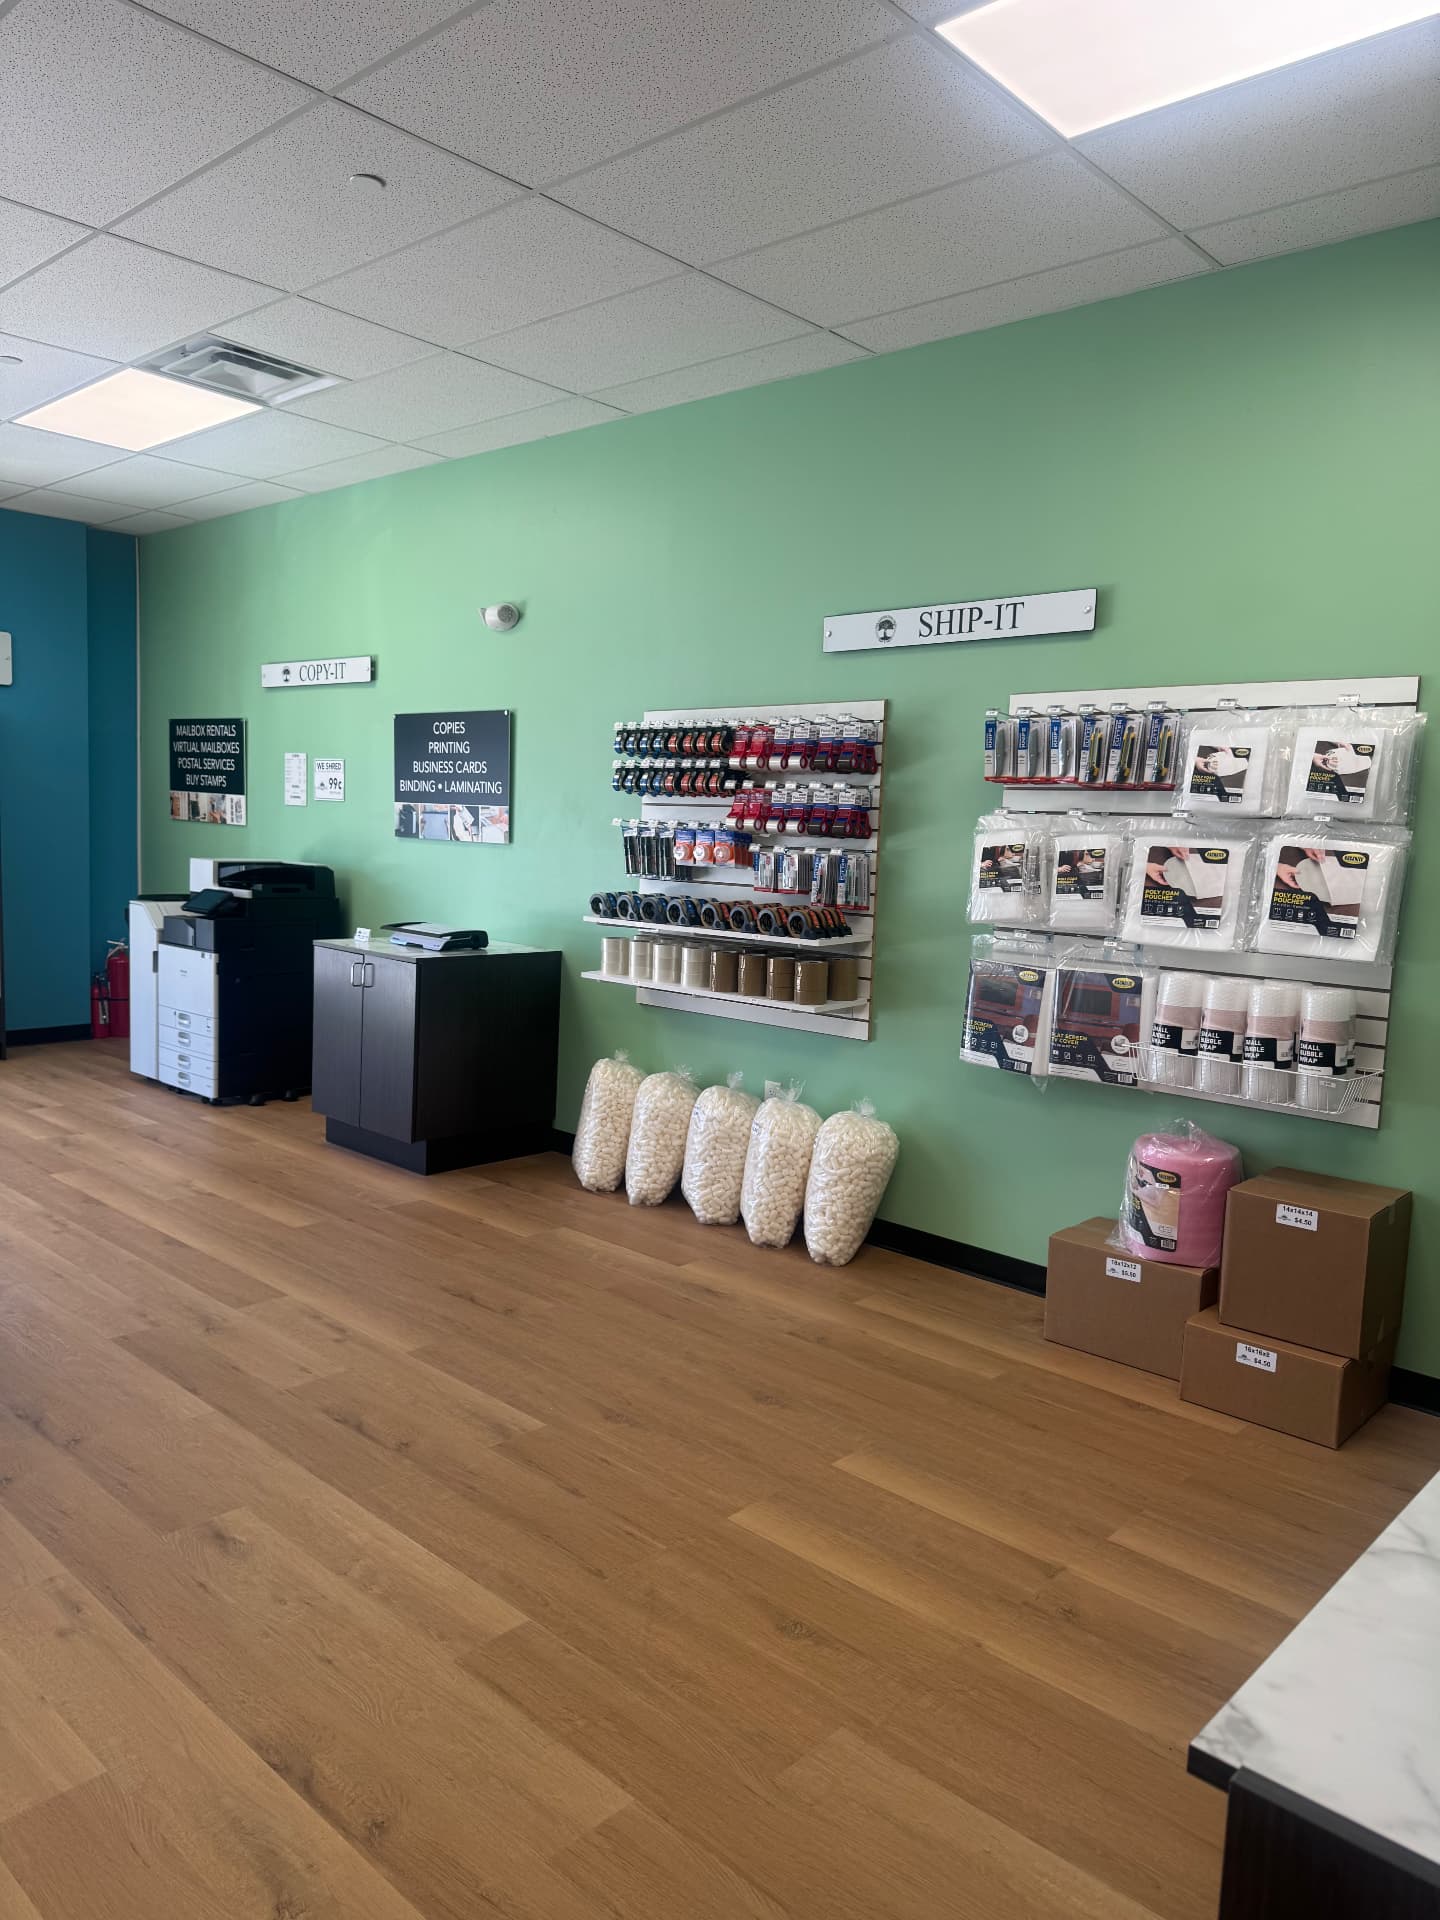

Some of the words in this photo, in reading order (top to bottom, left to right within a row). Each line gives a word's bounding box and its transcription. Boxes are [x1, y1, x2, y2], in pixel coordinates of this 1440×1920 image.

[919, 602, 1025, 638] SHIP-IT
[299, 662, 346, 681] COPY-IT
[176, 724, 206, 737] MAILBOX
[206, 724, 236, 737] RENTALS
[433, 721, 465, 734] COPIES
[172, 741, 200, 753] VIRTUAL
[201, 742, 240, 754] MAILBOXES
[428, 741, 470, 753] PRINTING
[178, 757, 201, 769] POSTAL
[202, 758, 235, 771] SERVICES
[317, 762, 325, 770] WE
[325, 762, 342, 770] SHRED
[413, 761, 453, 773] BUSINESS
[456, 761, 487, 774] CARDS
[186, 774, 199, 785] BUY
[200, 774, 227, 787] STAMPS
[329, 777, 342, 790] 99¢
[400, 780, 435, 792] BINDING
[444, 781, 502, 794] LAMINATING
[1273, 897, 1304, 905] POUCHES
[1201, 1030, 1219, 1038] SMALL
[1300, 1043, 1320, 1051] SMALL
[1300, 1049, 1324, 1057] BUBBLE
[1300, 1056, 1318, 1064] WRAP
[1283, 1205, 1313, 1217] 14x14x14
[1294, 1217, 1312, 1226] $4.50
[1254, 1357, 1271, 1367] $4.50
